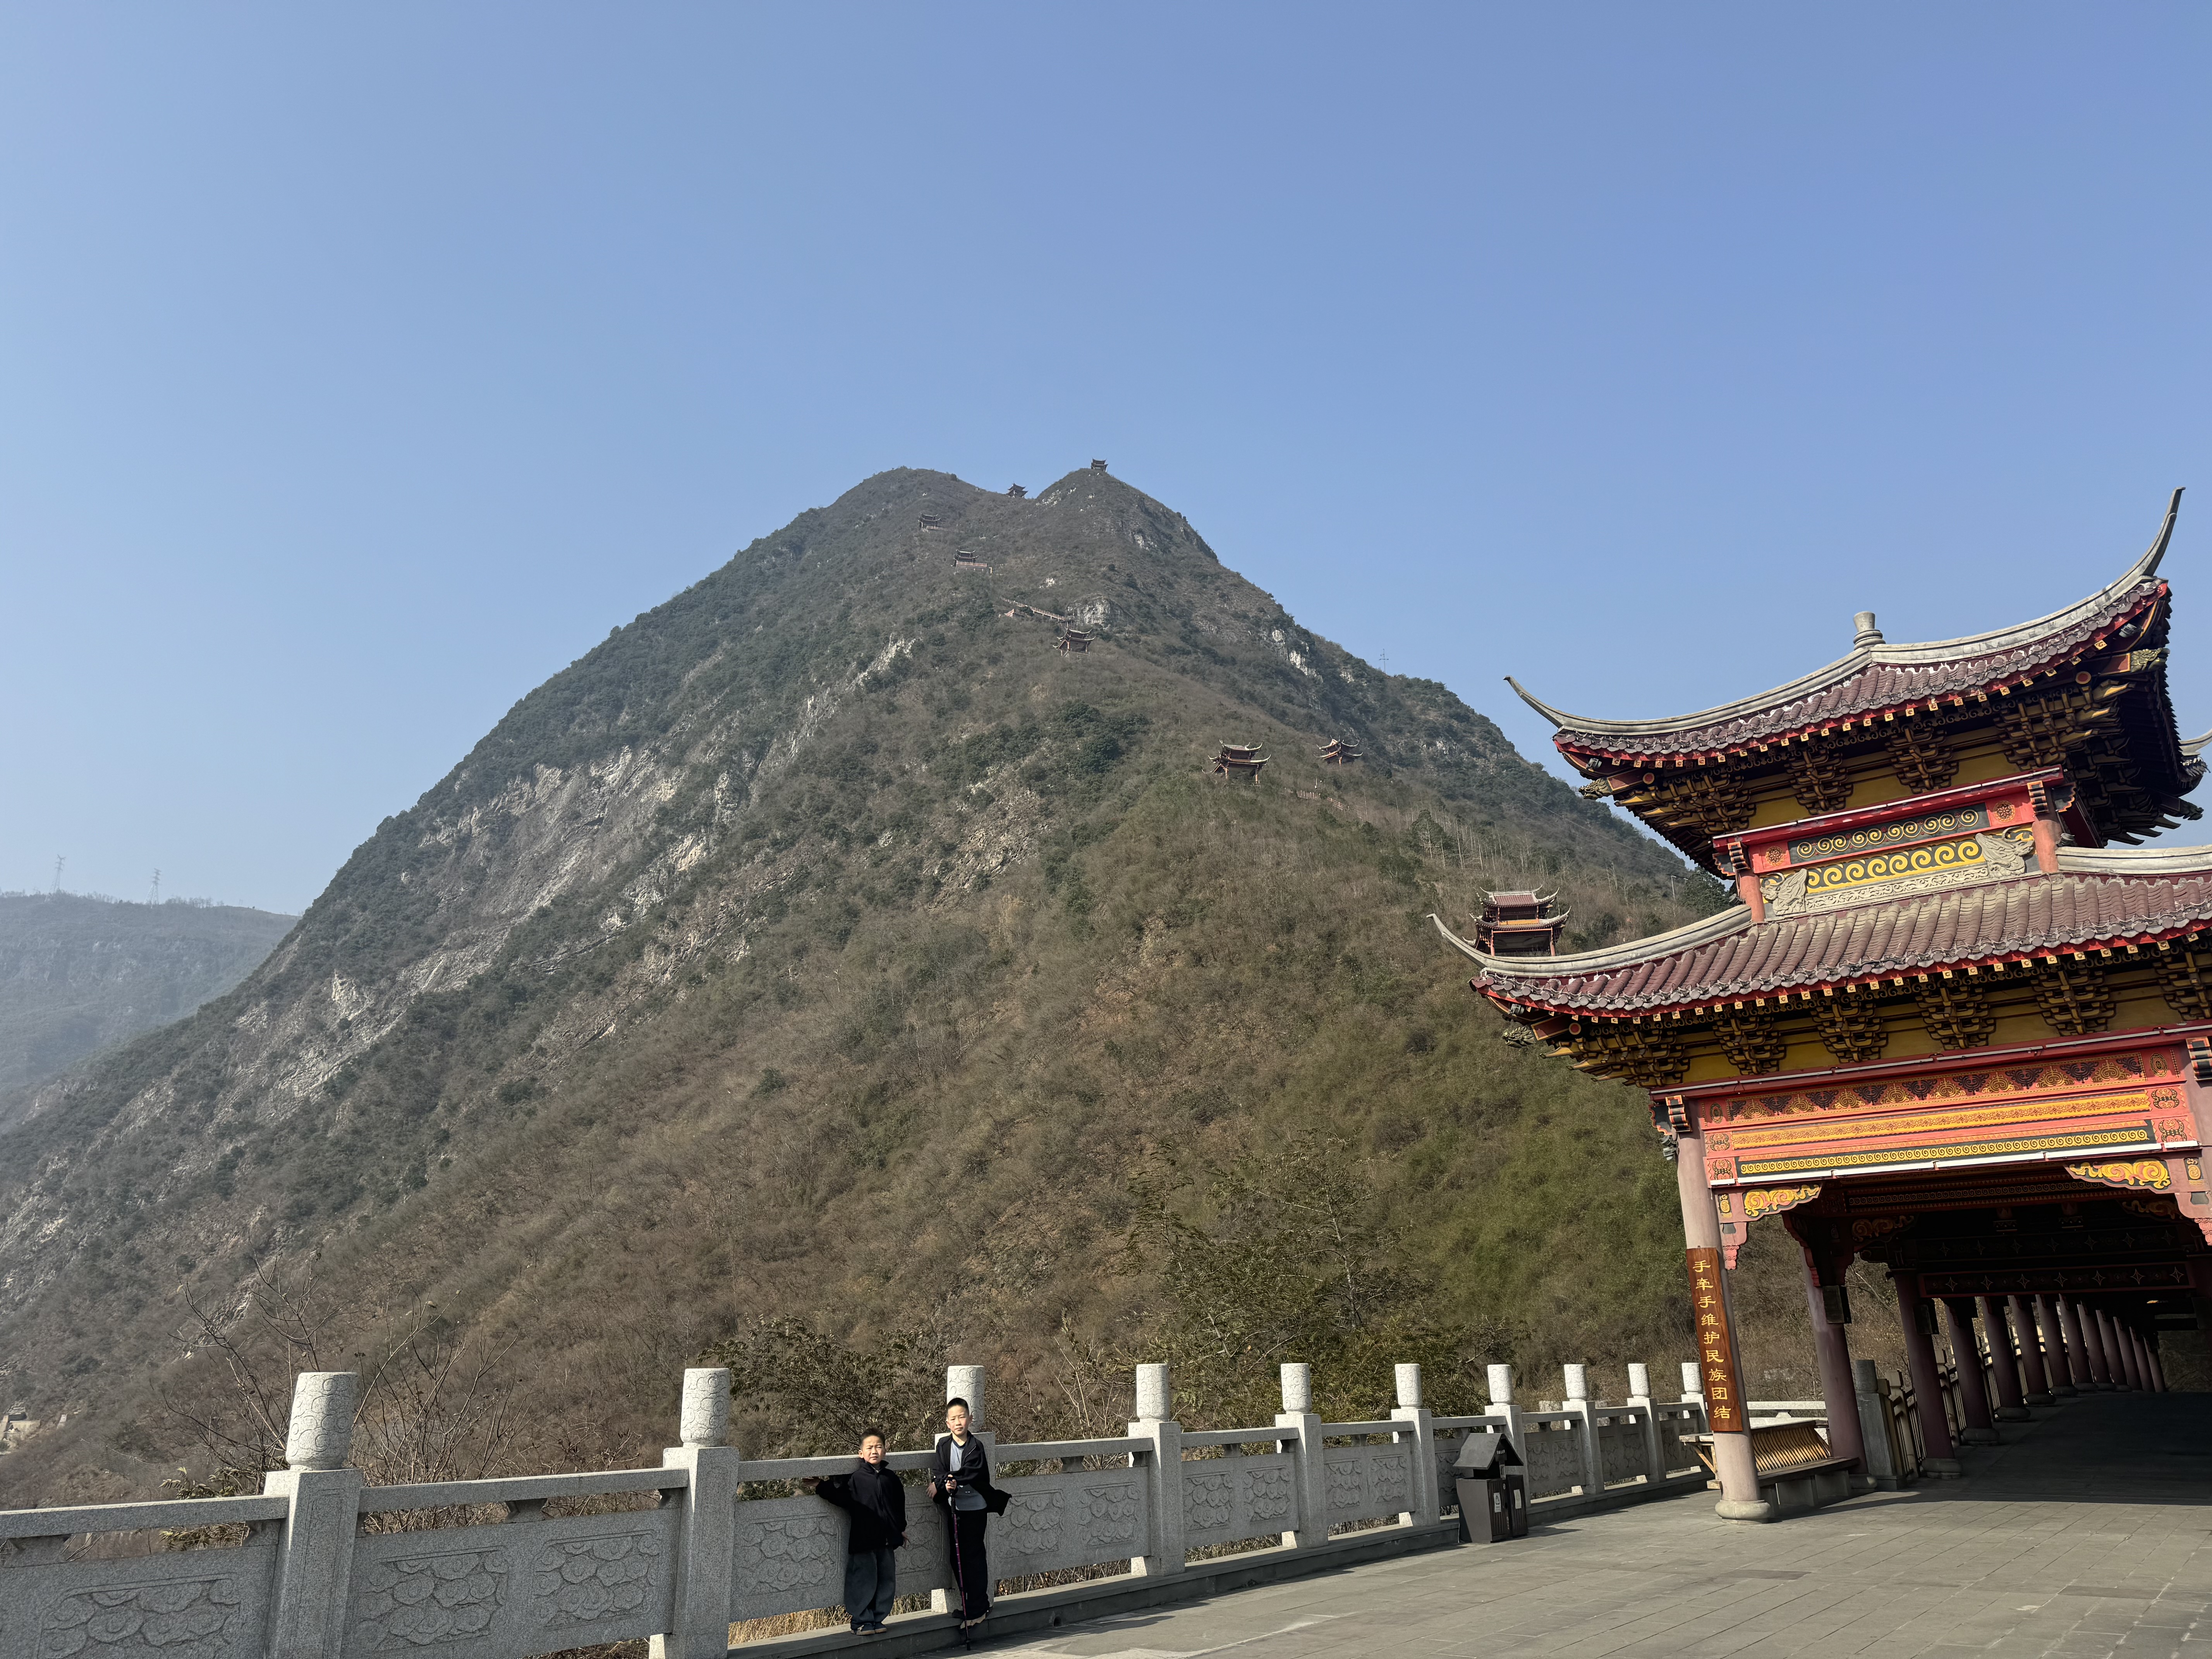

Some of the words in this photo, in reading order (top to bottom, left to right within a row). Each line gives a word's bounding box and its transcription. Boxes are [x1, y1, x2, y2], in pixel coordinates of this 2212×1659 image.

[1693, 1260, 1731, 1419] 手牵手维护民族团结
